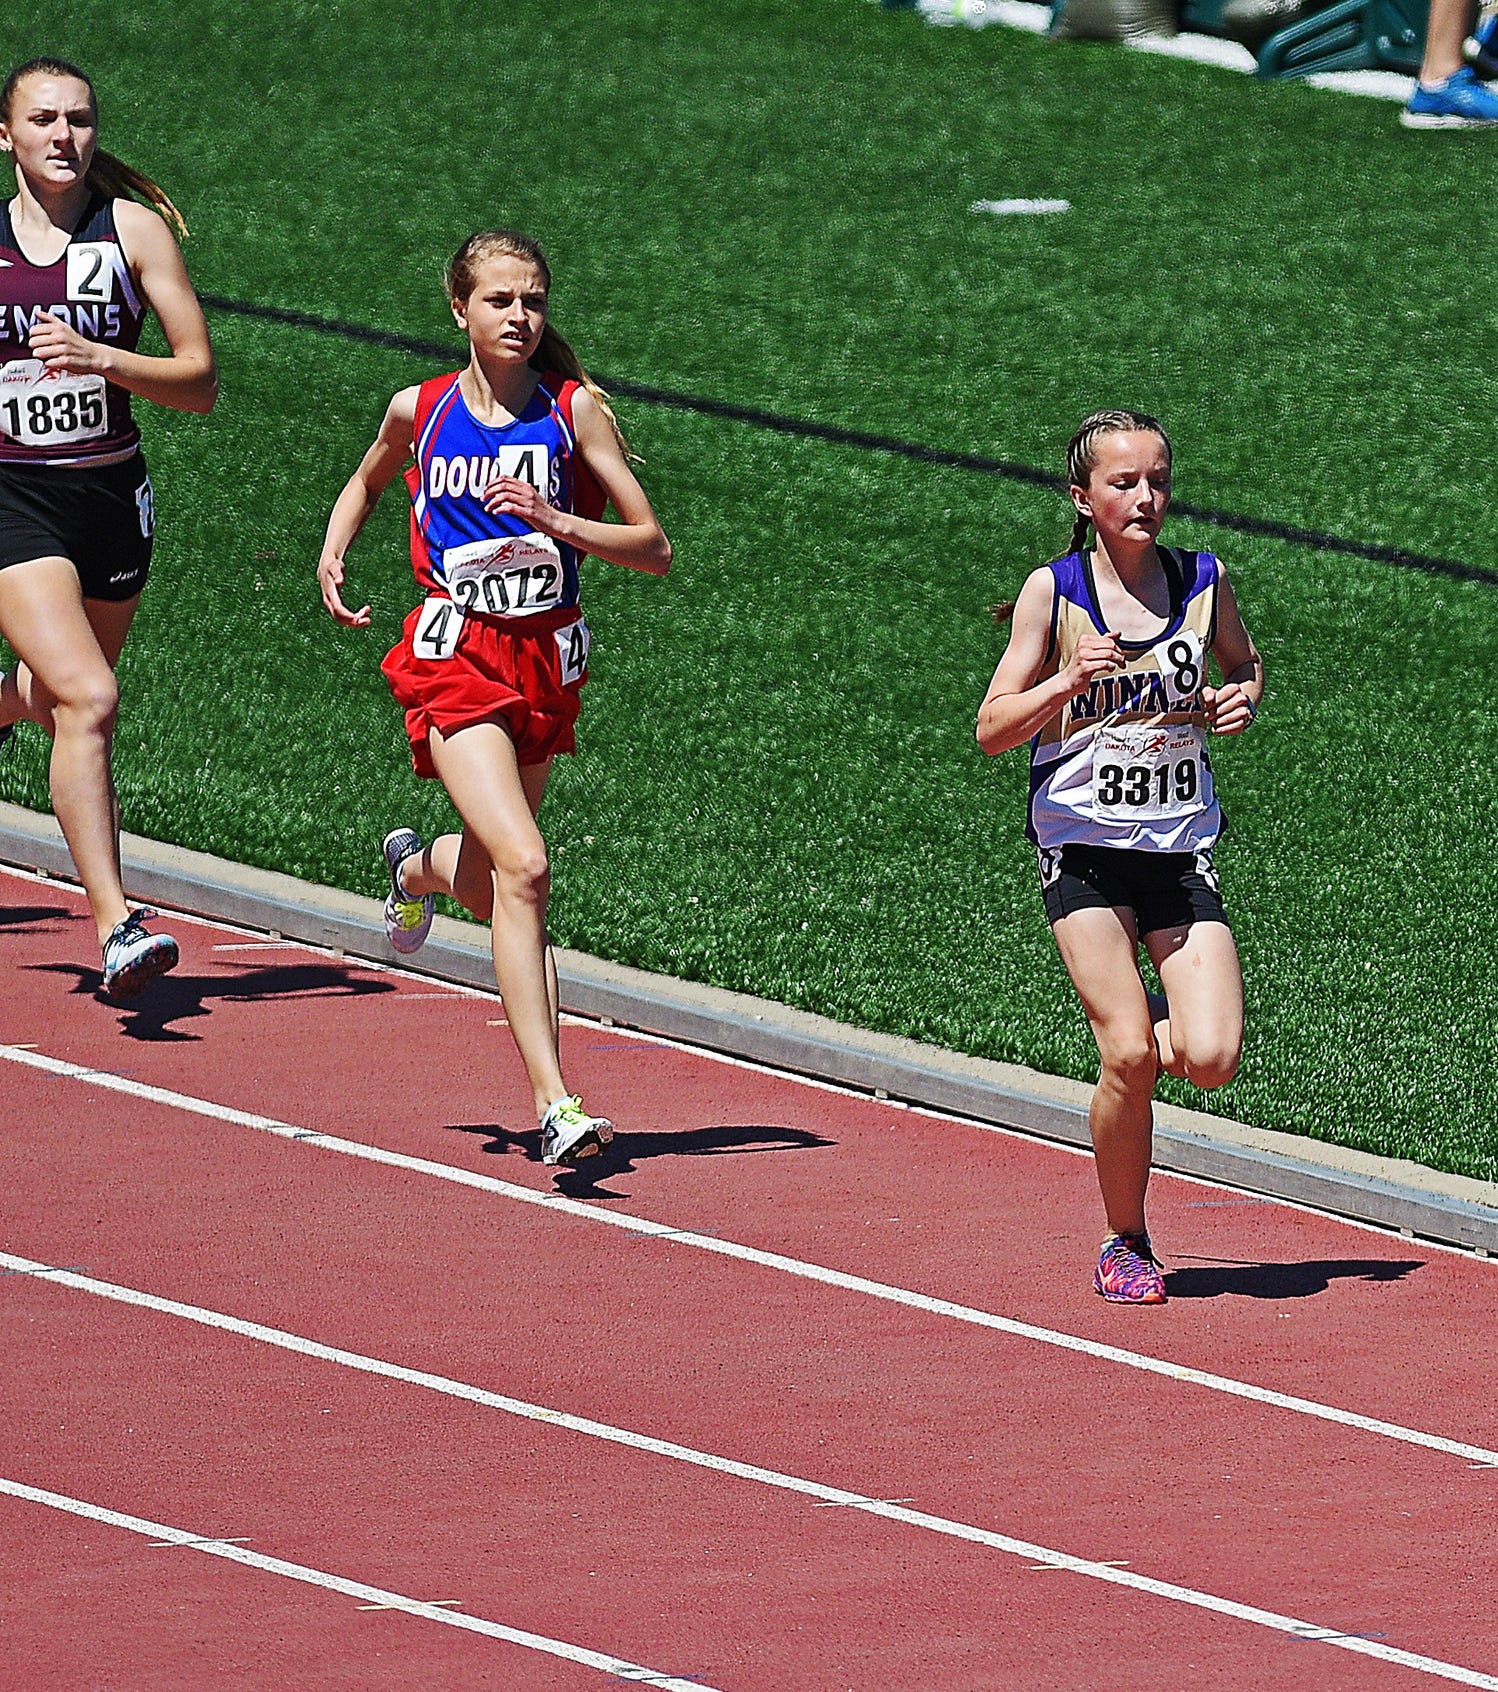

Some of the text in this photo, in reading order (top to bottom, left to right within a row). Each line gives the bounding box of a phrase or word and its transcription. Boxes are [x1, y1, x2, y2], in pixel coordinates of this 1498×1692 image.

[77, 247, 104, 297] 2
[2, 387, 104, 437] 1835
[429, 455, 560, 499] DOUS
[513, 450, 540, 493] 4
[455, 563, 558, 614] 2072
[421, 603, 453, 656] 4
[567, 624, 587, 676] 4
[1167, 639, 1200, 695] 8
[1070, 671, 1202, 722] WINN
[1169, 739, 1195, 750] RELAYS
[1097, 758, 1197, 807] 3319
